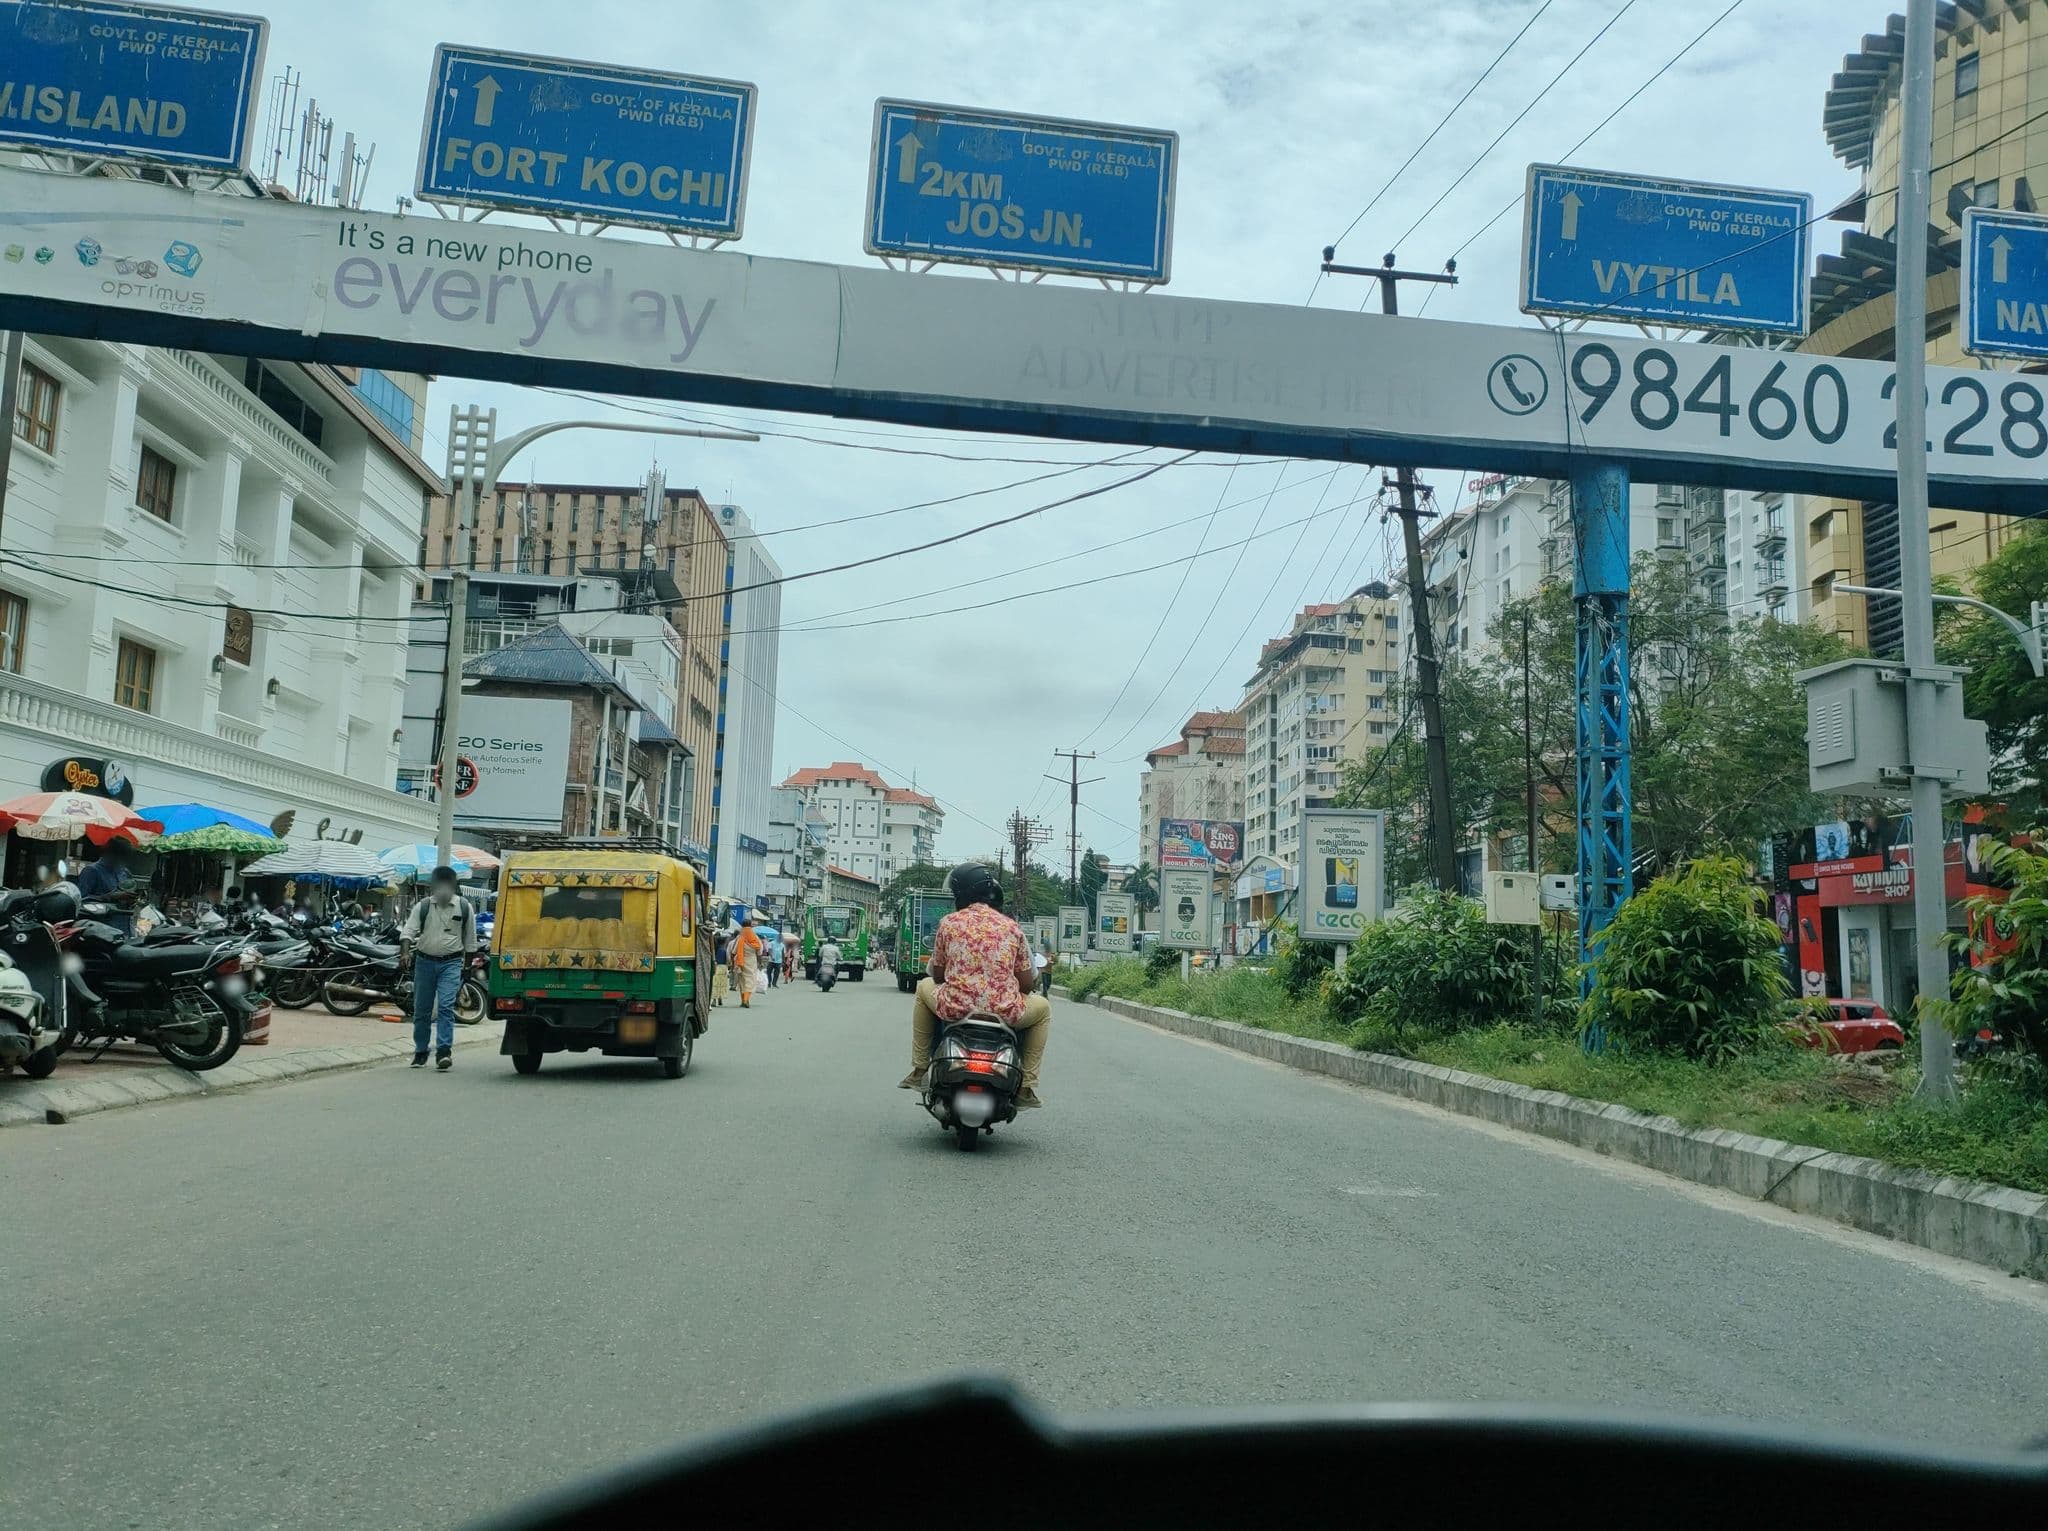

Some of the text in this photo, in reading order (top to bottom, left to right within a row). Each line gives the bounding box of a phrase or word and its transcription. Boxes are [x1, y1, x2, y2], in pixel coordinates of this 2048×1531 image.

[90, 25, 241, 53] GOVT. OF KERALA
[119, 40, 212, 64] PWD (R&B)
[591, 91, 733, 121] GOVT. OF KERALA
[618, 108, 705, 131] PWD (R&B)
[1022, 143, 1156, 169] GOVT. OF KERALA
[443, 136, 726, 208] FORT KOCHI
[919, 161, 1004, 201] 2KM
[1048, 158, 1129, 180] PWD (R&B)
[946, 201, 1093, 249] JOS JN.
[1664, 204, 1791, 228] GOVT. OF KERALA
[1688, 219, 1766, 239] PWD (R&B)
[338, 221, 593, 274] It's a new phone
[1592, 258, 1742, 307] VYTILA
[334, 255, 718, 364] everyday
[1996, 298, 2048, 336] NA
[1569, 341, 1850, 446] 98460
[489, 739, 543, 752] Series
[480, 754, 519, 765] Autofocus
[492, 766, 526, 776] Moment
[1210, 840, 1236, 850] SALE
[1211, 832, 1235, 841] KING
[1885, 885, 1911, 897] SHOP
